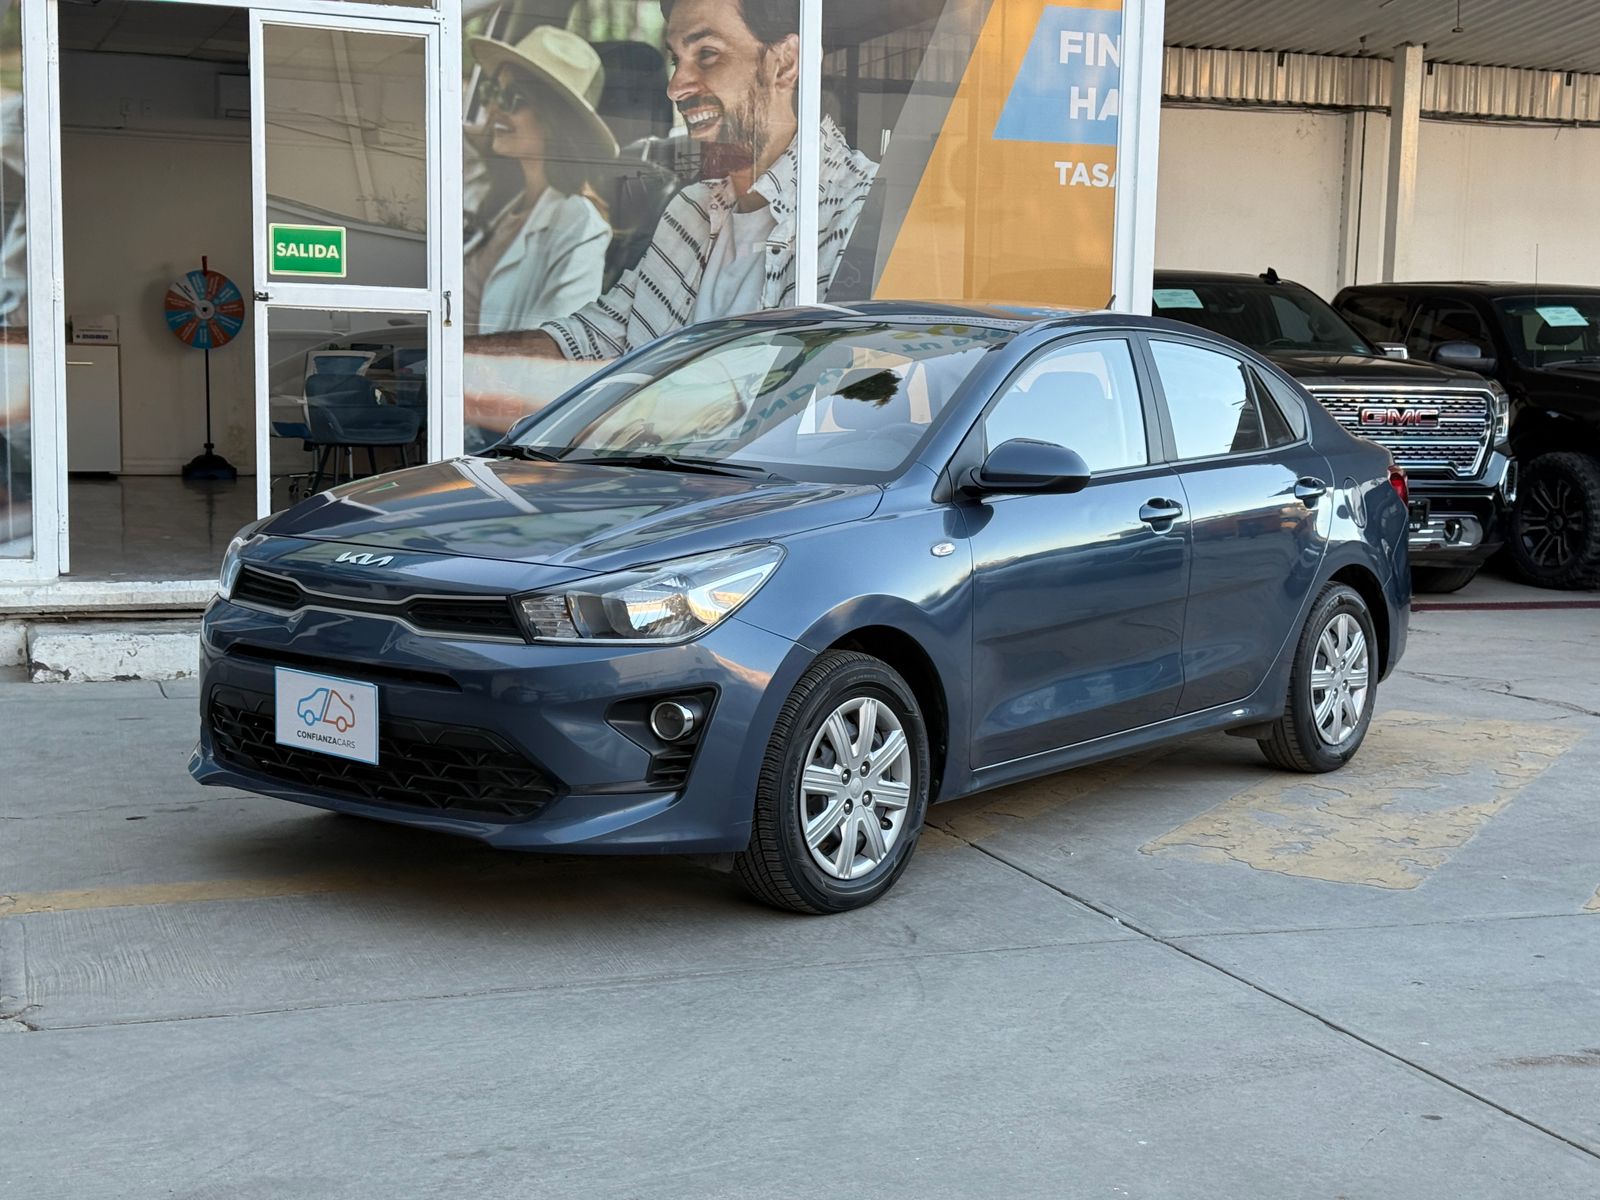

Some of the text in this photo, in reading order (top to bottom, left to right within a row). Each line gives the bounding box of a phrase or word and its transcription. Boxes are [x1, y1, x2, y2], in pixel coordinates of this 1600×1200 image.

[1060, 31, 1120, 67] FIN
[276, 242, 339, 259] SALIDA
[1361, 408, 1439, 426] GMC
[335, 551, 394, 567] KIA
[296, 729, 356, 749] CONFIANZACARS
